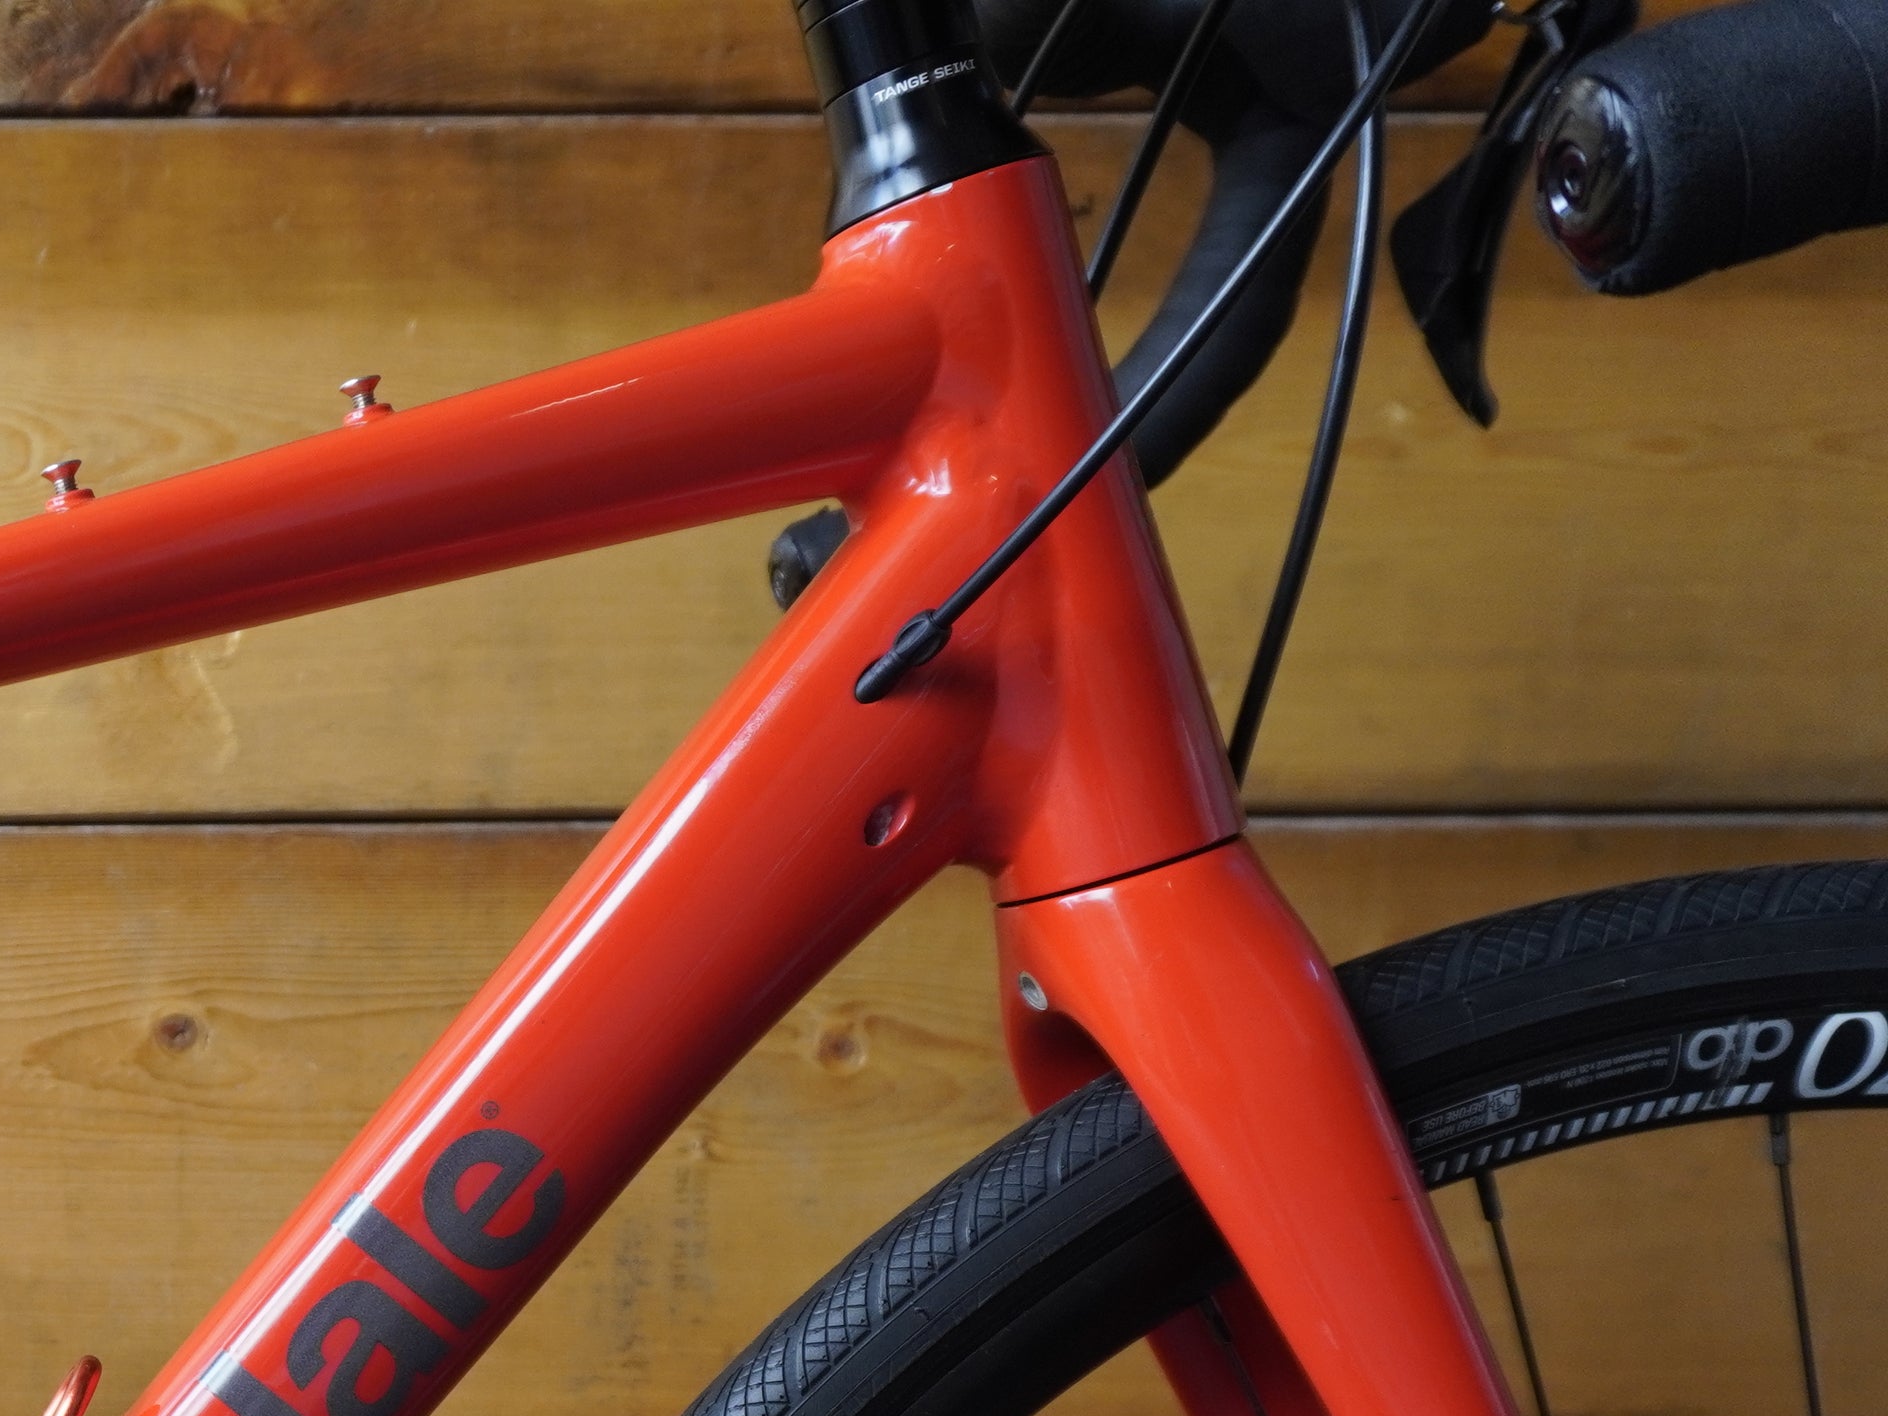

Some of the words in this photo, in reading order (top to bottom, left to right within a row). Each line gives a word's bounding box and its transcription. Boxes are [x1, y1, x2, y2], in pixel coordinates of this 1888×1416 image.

[873, 71, 930, 103] TANGE
[933, 59, 976, 79] SEIKI
[1423, 1115, 1444, 1132] USE
[1445, 1100, 1487, 1124] BEFORE
